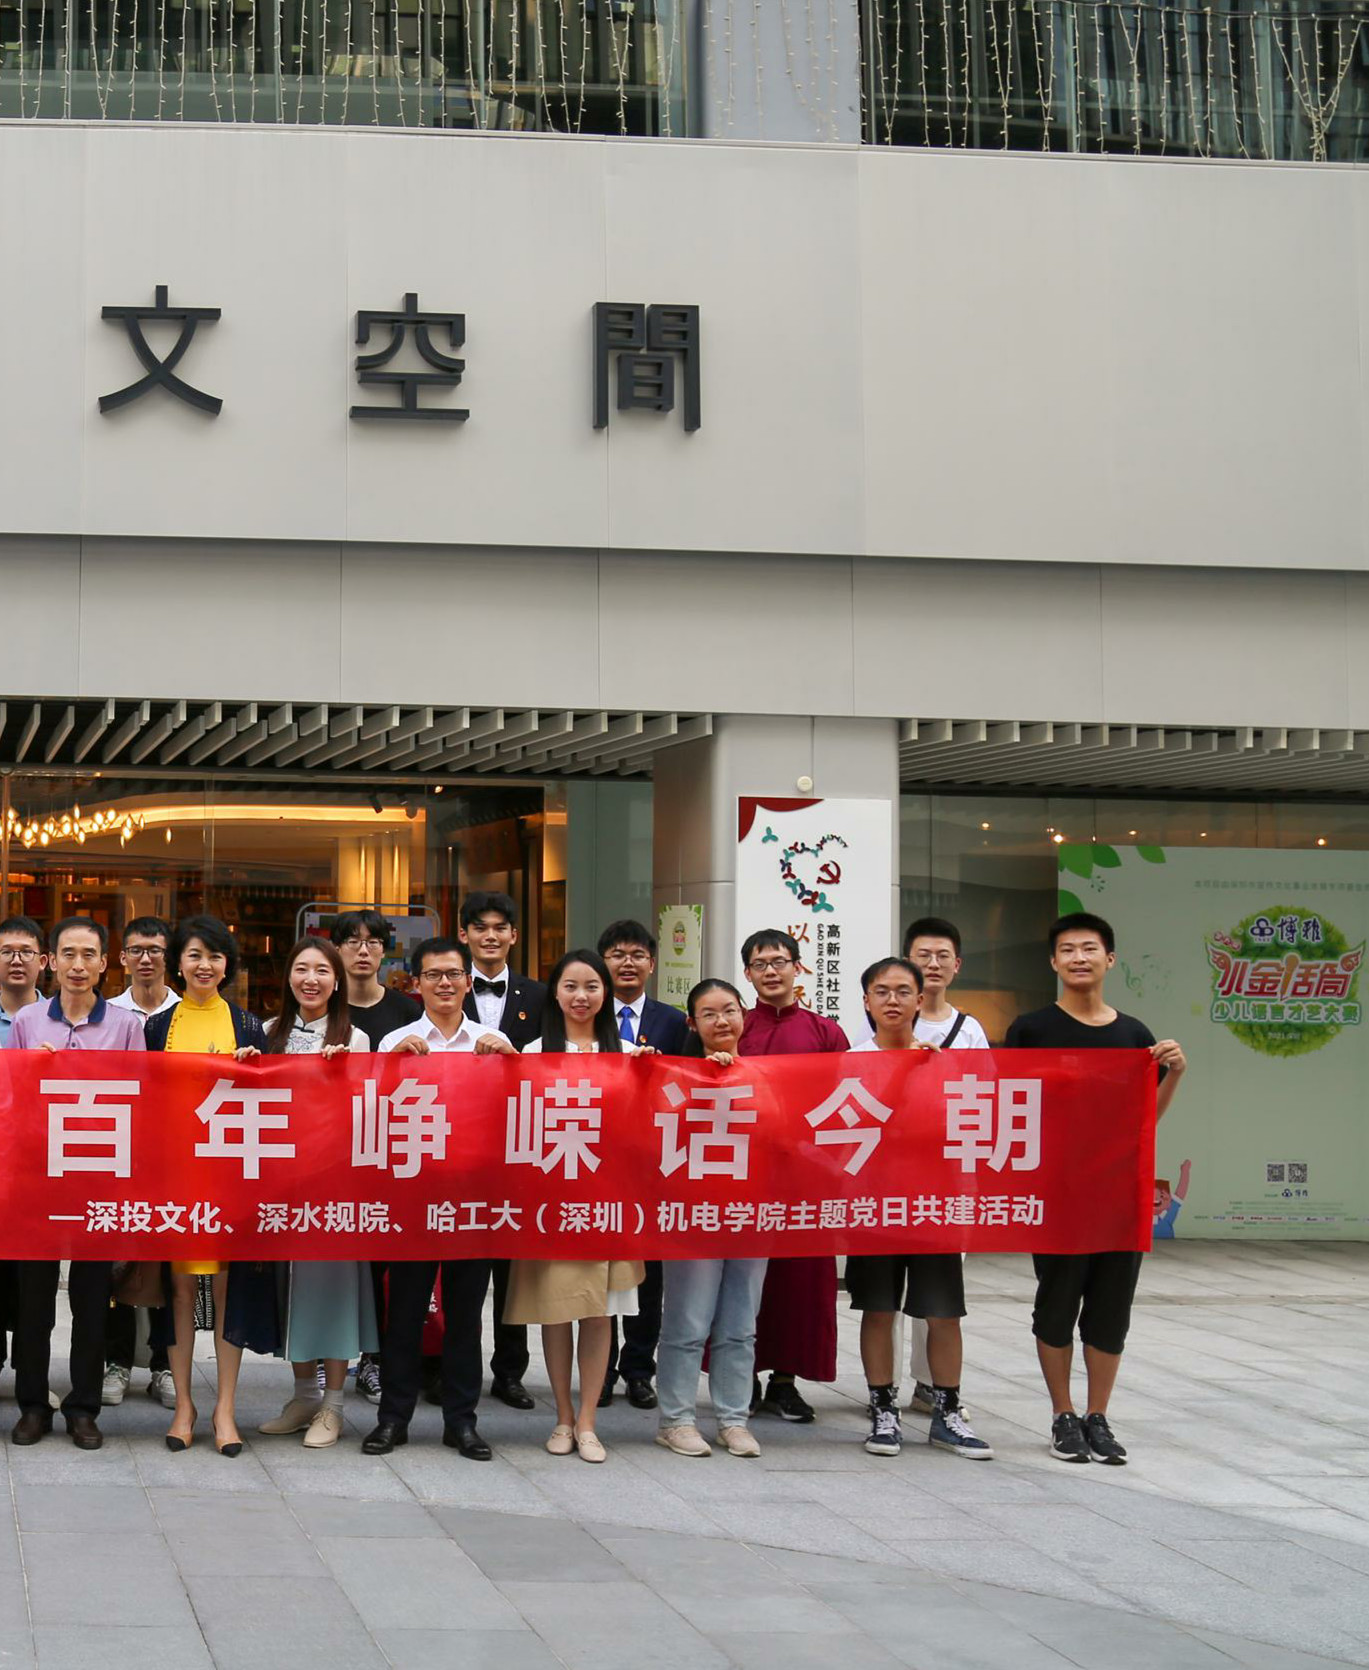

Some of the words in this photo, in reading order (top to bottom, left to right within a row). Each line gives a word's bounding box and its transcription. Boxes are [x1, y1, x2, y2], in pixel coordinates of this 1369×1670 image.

[1277, 916, 1321, 943] 博雅
[816, 959, 824, 971] QU
[816, 990, 824, 1003] QU
[1213, 1002, 1359, 1022] 少儿语言才艺大赛
[39, 1074, 1043, 1180] 百年峥嵘话今朝
